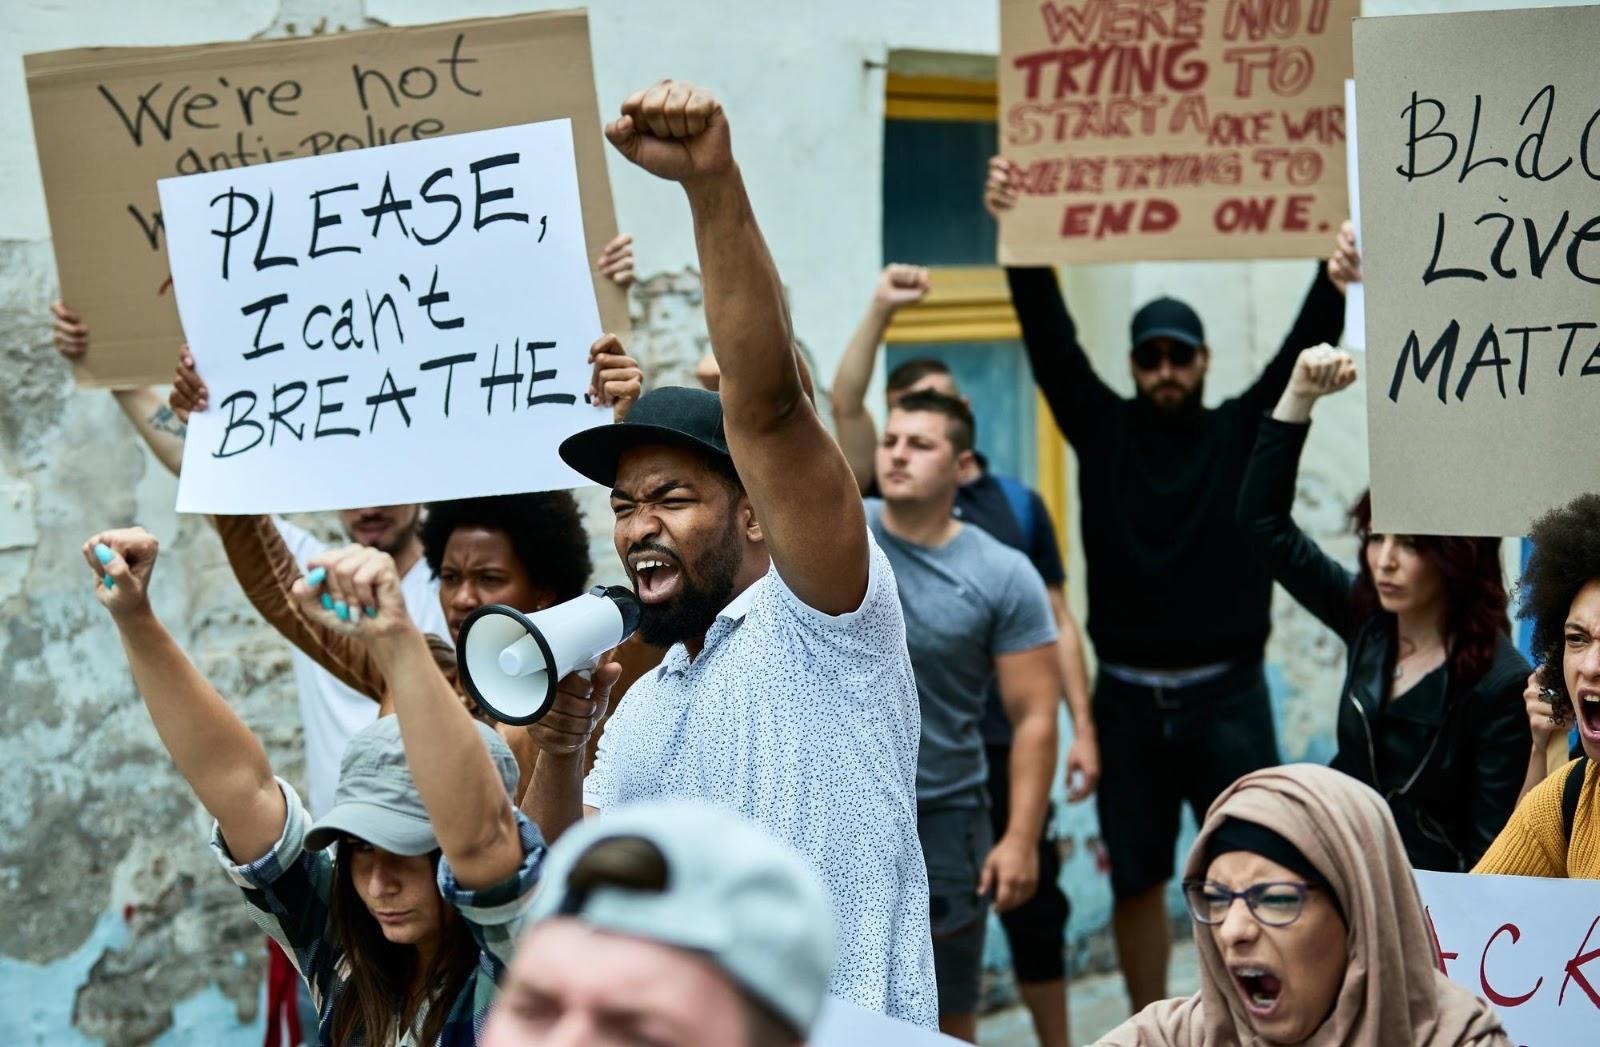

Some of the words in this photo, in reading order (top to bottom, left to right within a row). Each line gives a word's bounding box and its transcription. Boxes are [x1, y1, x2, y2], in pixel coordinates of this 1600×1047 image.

[98, 77, 303, 148] We're
[353, 33, 484, 111] not
[1013, 42, 1209, 100] TRYING
[1223, 45, 1315, 98] TO
[1007, 94, 1169, 145] START
[1281, 104, 1346, 147] WAR
[1112, 149, 1243, 191] TRYING
[1253, 148, 1325, 187] TO
[209, 152, 549, 280] PLEASE,
[1059, 198, 1181, 241] END
[1212, 194, 1331, 235] ONE.
[241, 293, 289, 360] I
[302, 264, 465, 354] can't
[212, 338, 592, 458] BREATHE.
